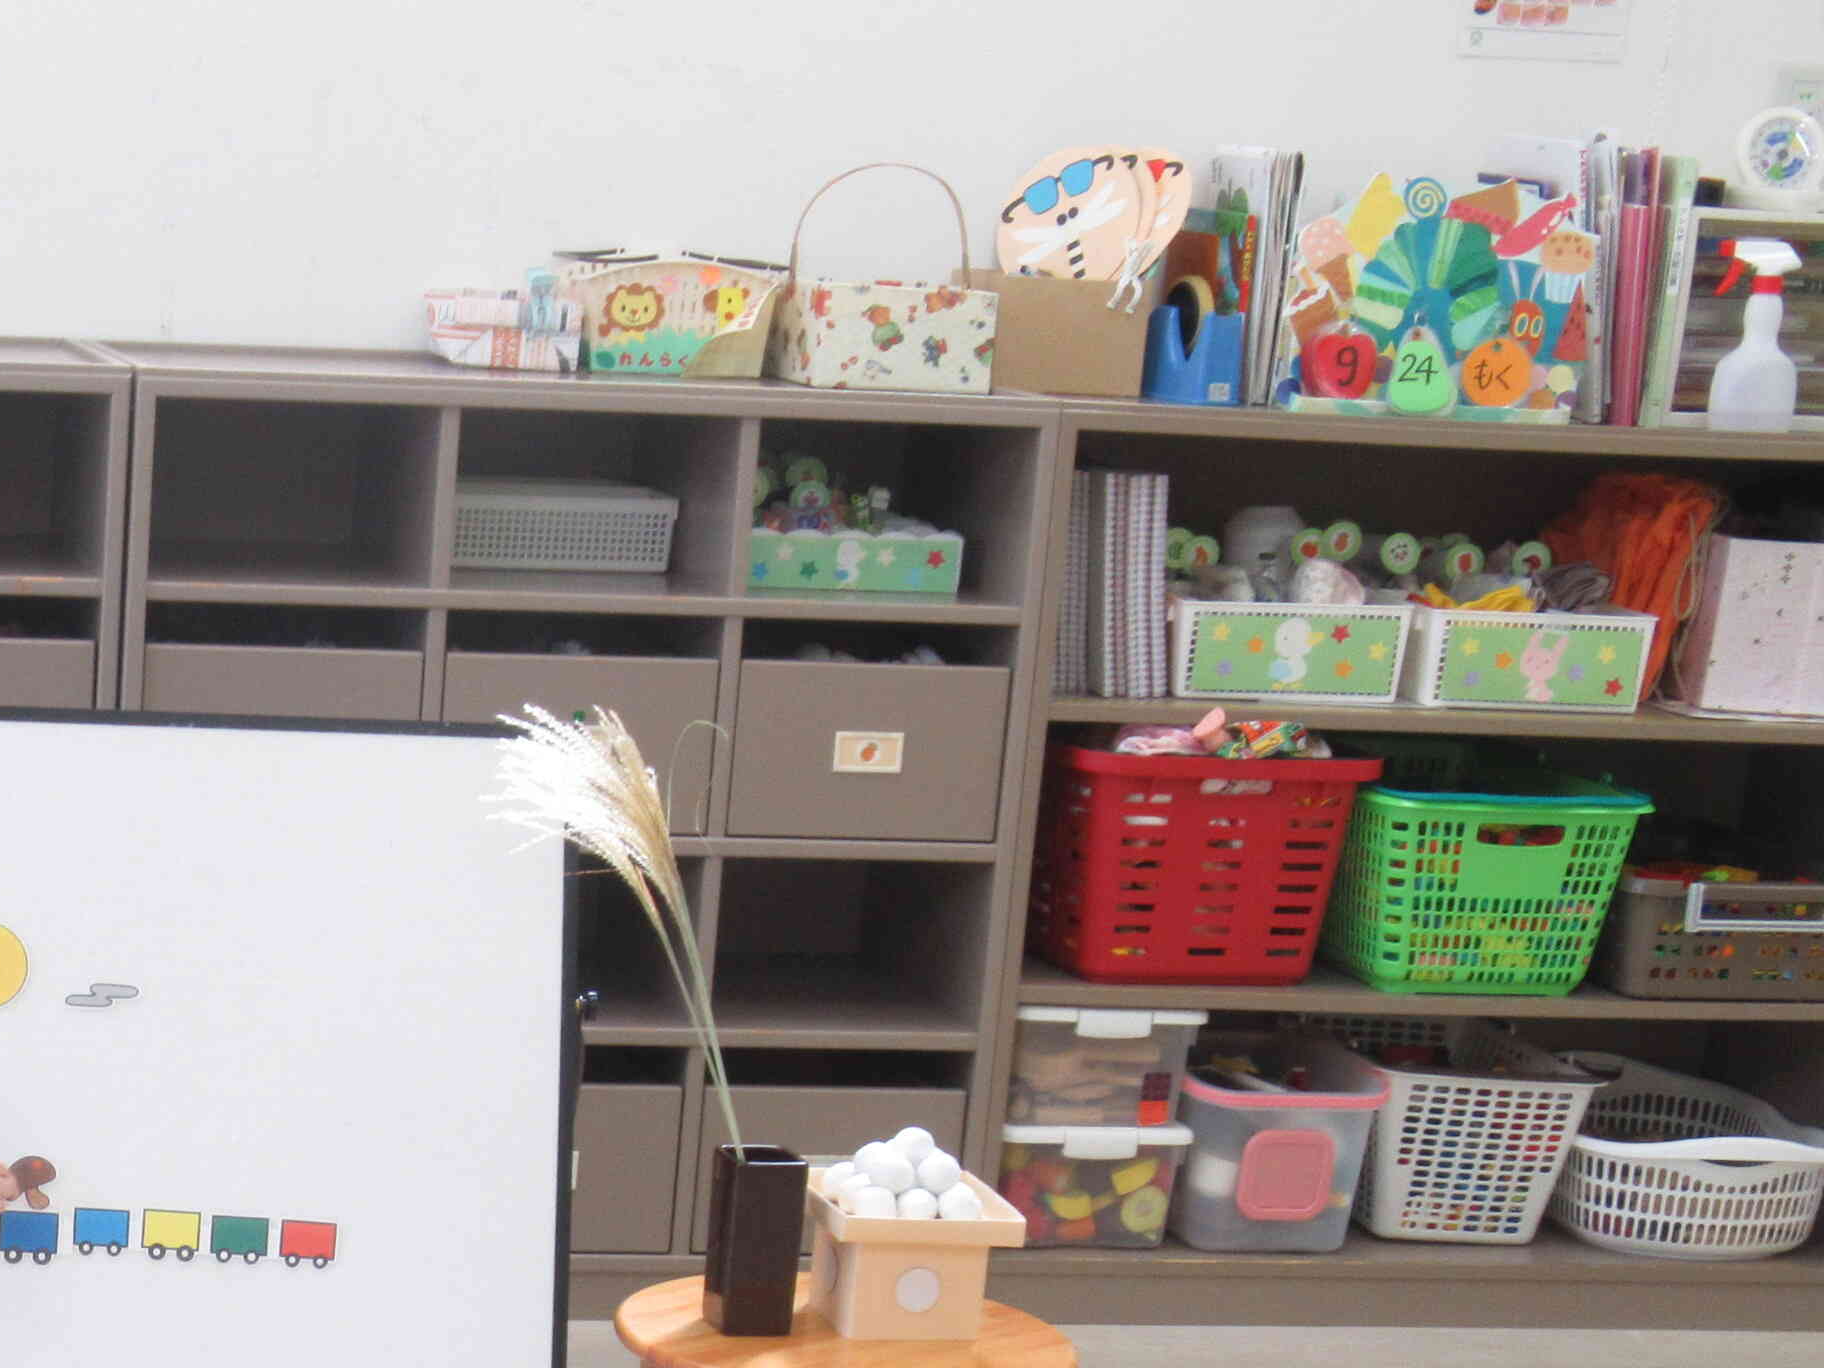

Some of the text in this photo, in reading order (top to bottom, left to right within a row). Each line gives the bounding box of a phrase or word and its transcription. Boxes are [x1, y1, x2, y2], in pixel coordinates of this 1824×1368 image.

[1336, 345, 1360, 387] 9
[1397, 353, 1439, 385] 24
[1474, 359, 1514, 391] もく
